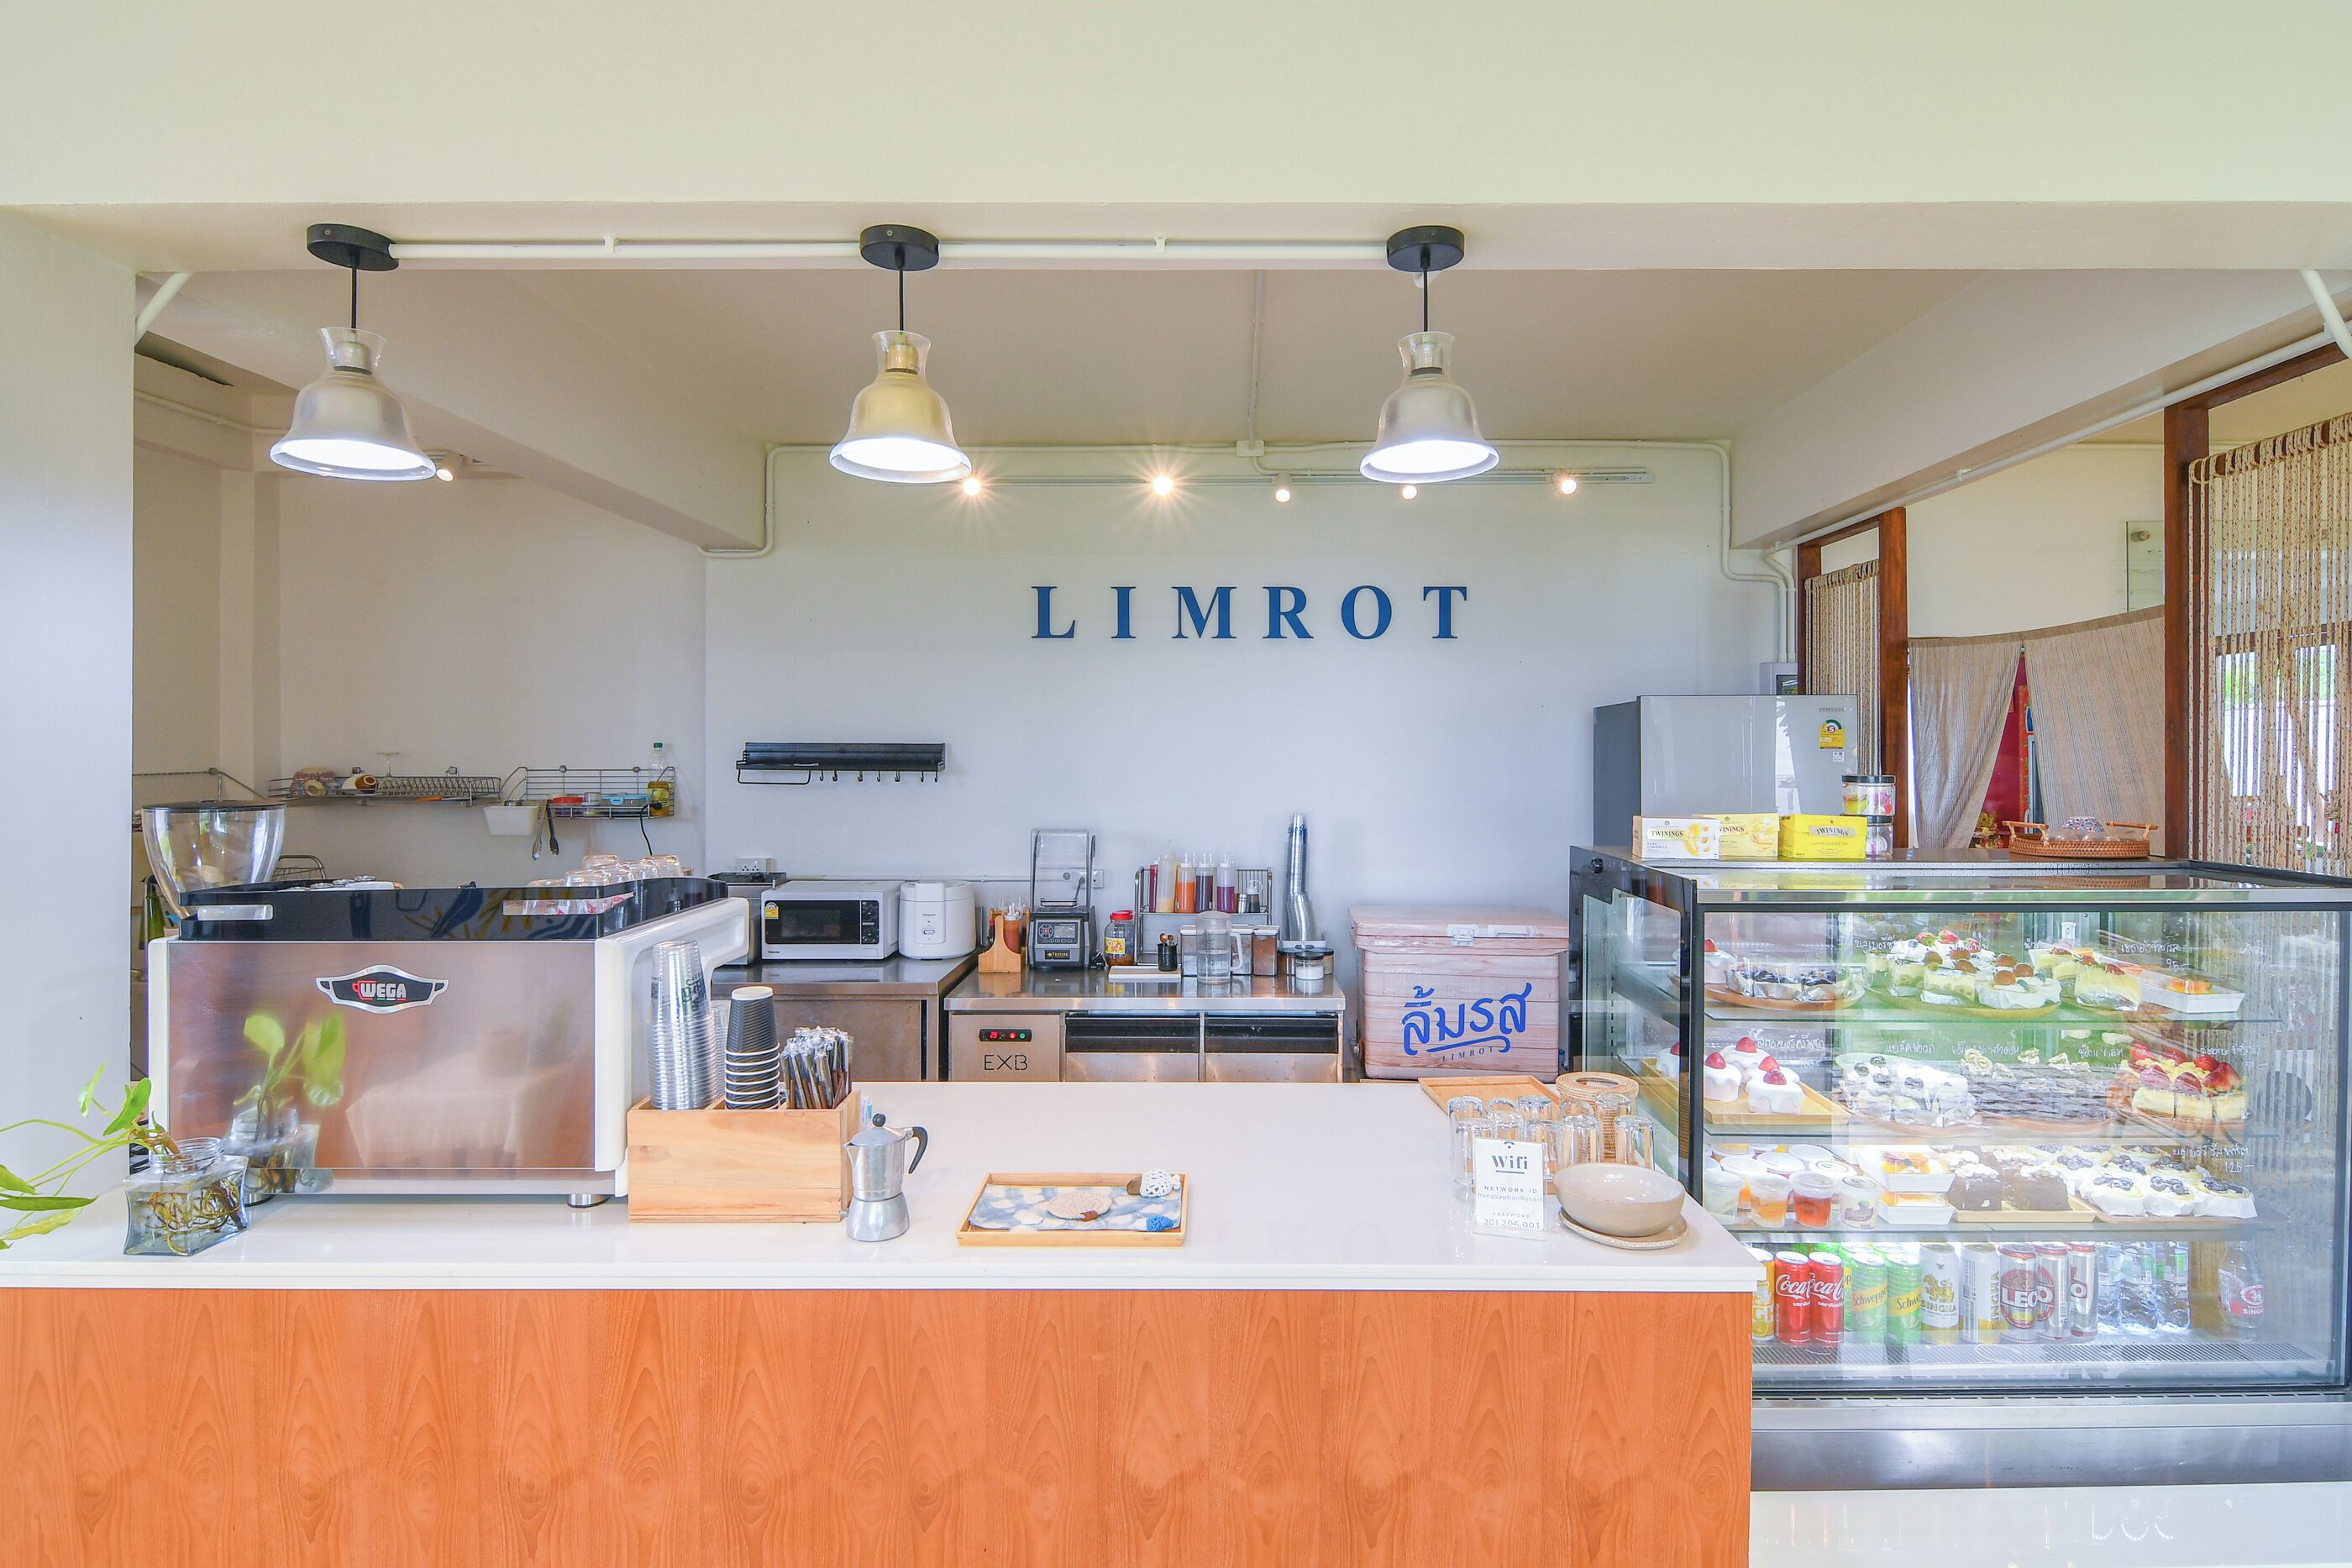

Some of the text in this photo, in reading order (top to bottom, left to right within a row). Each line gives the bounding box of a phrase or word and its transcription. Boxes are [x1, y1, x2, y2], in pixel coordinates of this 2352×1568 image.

[1031, 585, 1467, 641] LIMROT
[1814, 827, 1850, 836] TWININGS
[360, 983, 407, 999] WEGA
[1401, 982, 1533, 1057] ลิ้มรส
[1442, 1046, 1494, 1062] LIMROT
[984, 1054, 1028, 1071] EXB
[1491, 1155, 1528, 1170] Wifi
[1483, 1185, 1525, 1193] NETWORK
[1502, 1219, 1520, 1228] 206
[1522, 1221, 1541, 1230] 003
[2001, 1286, 2038, 1309] LEO
[1921, 1299, 1957, 1314] SINGHA
